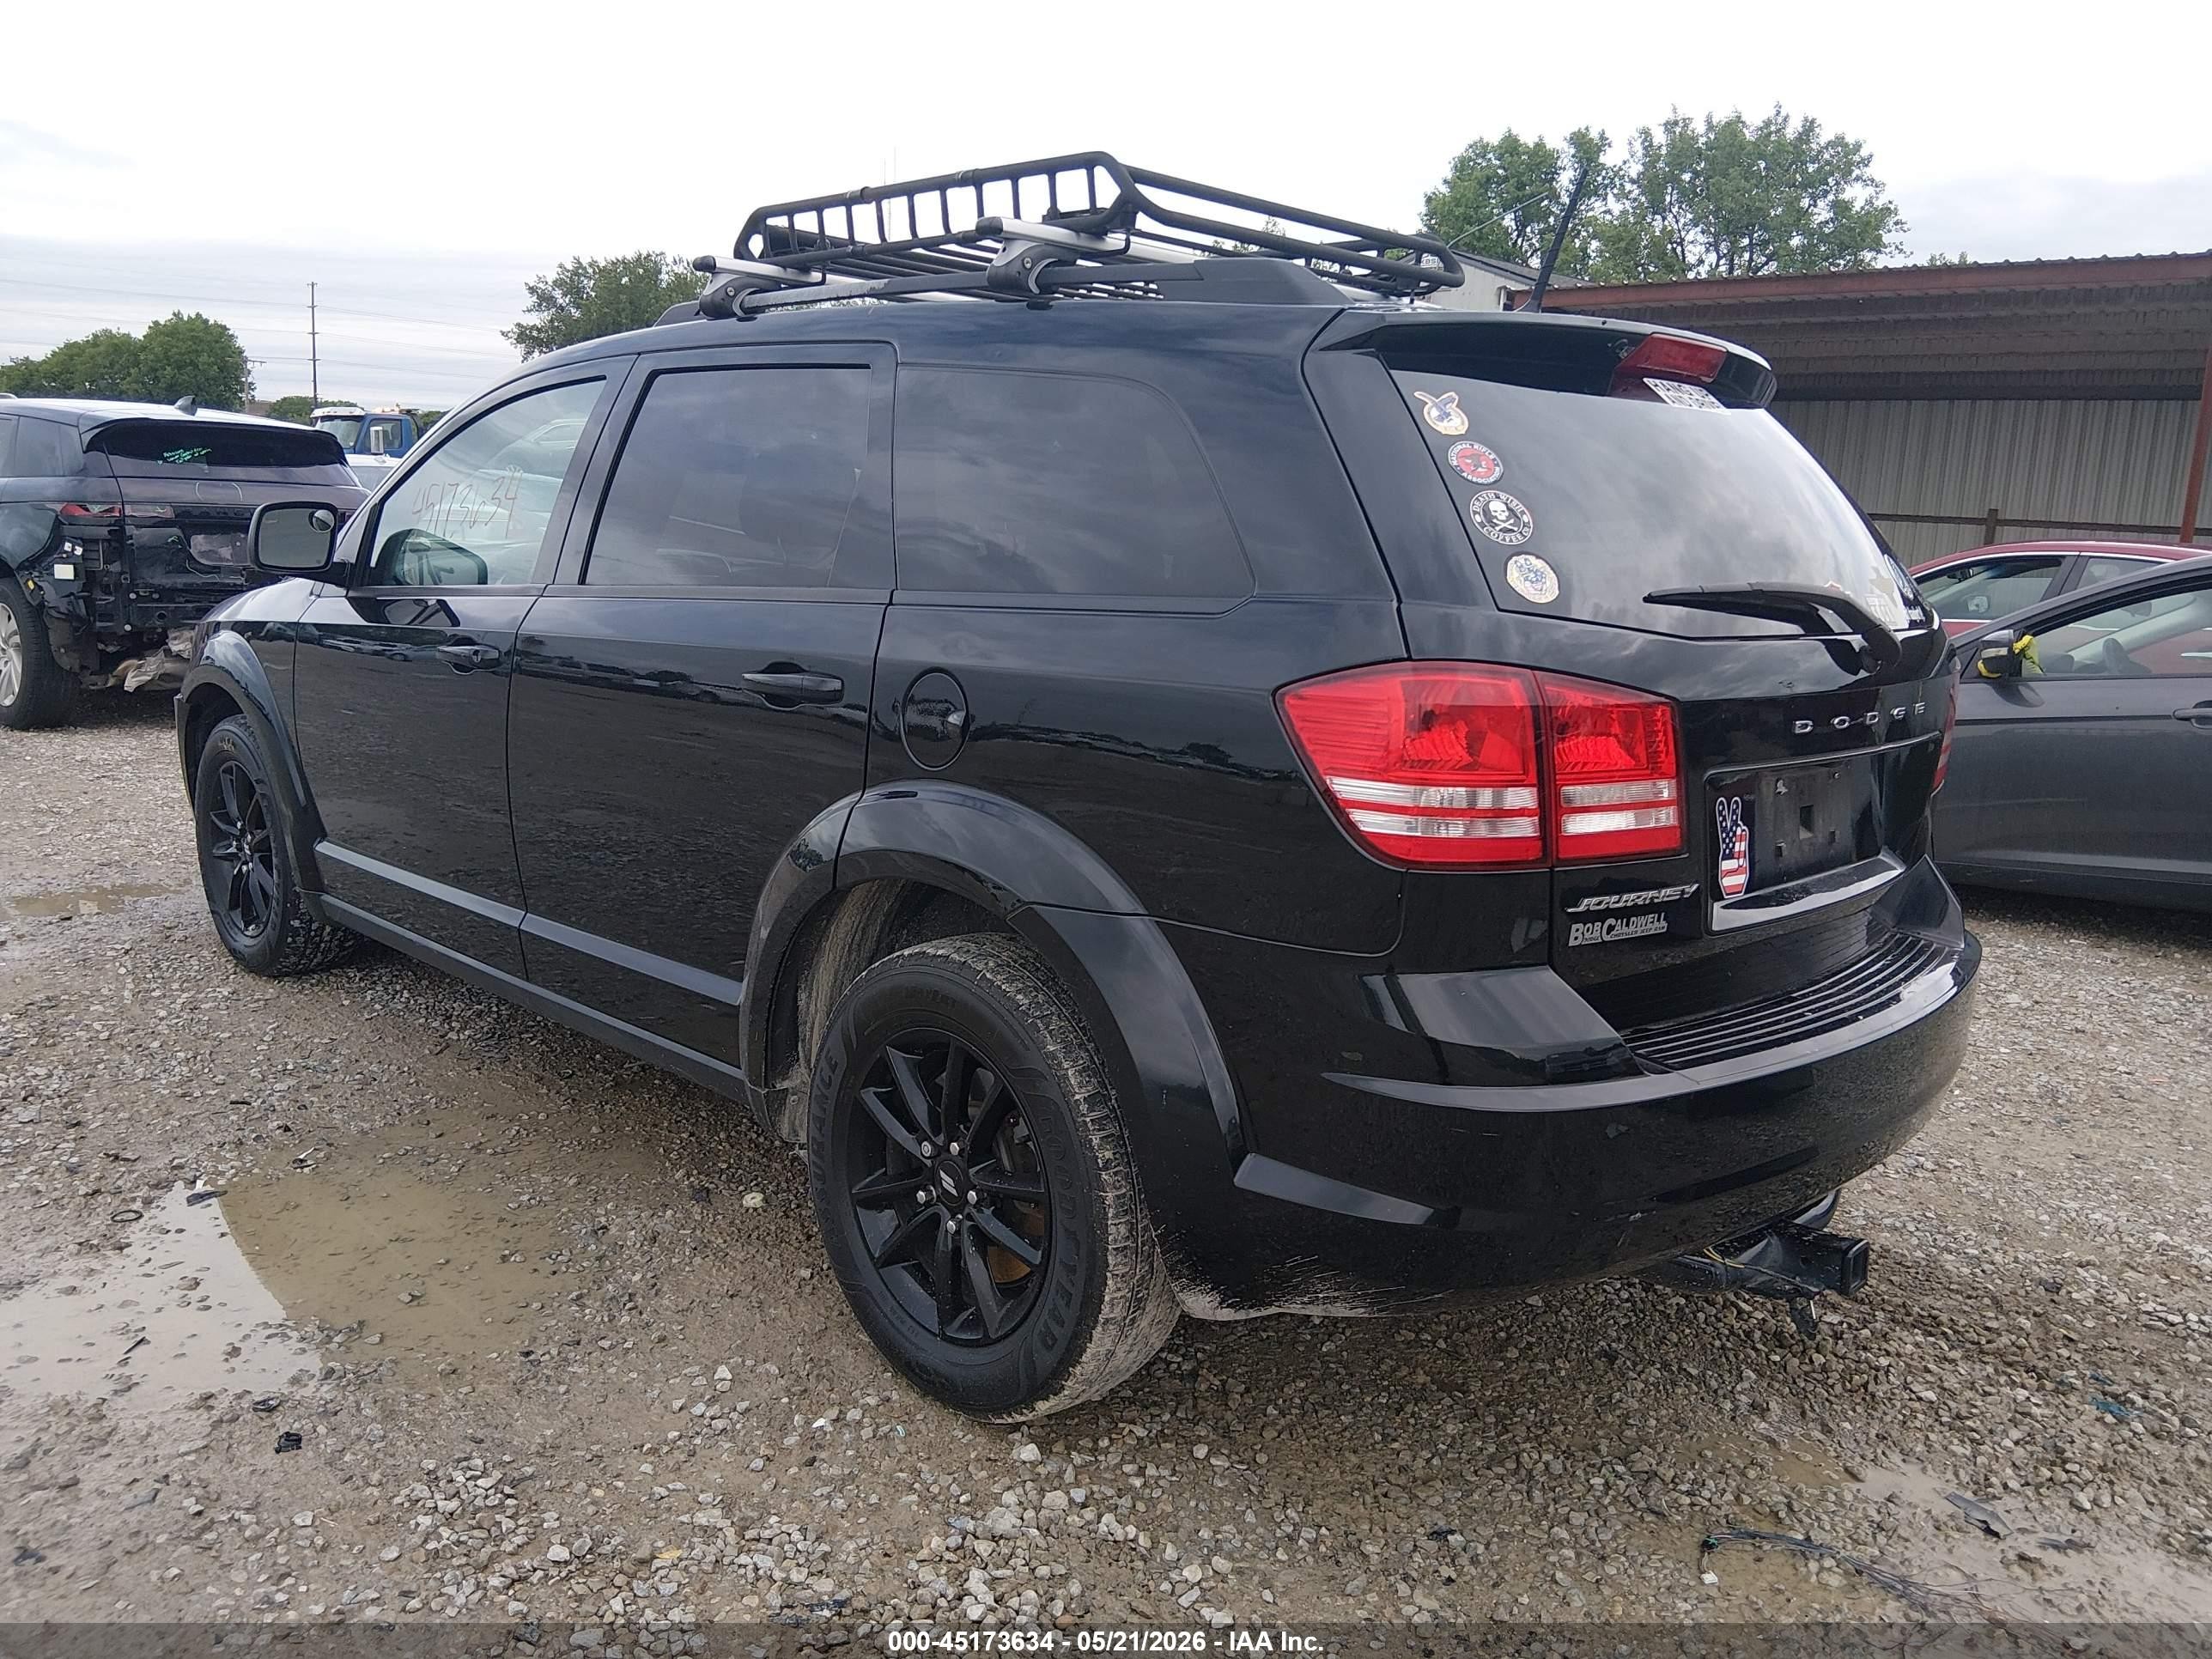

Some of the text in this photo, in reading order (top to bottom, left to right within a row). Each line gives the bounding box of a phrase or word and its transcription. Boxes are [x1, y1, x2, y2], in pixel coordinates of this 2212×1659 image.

[412, 471, 523, 538] 45173634
[1472, 492, 1523, 513] DEATH WISH
[1483, 526, 1524, 543] COFFEE
[1793, 702, 1926, 734] DODGE
[1565, 883, 1700, 913] JOURNEY
